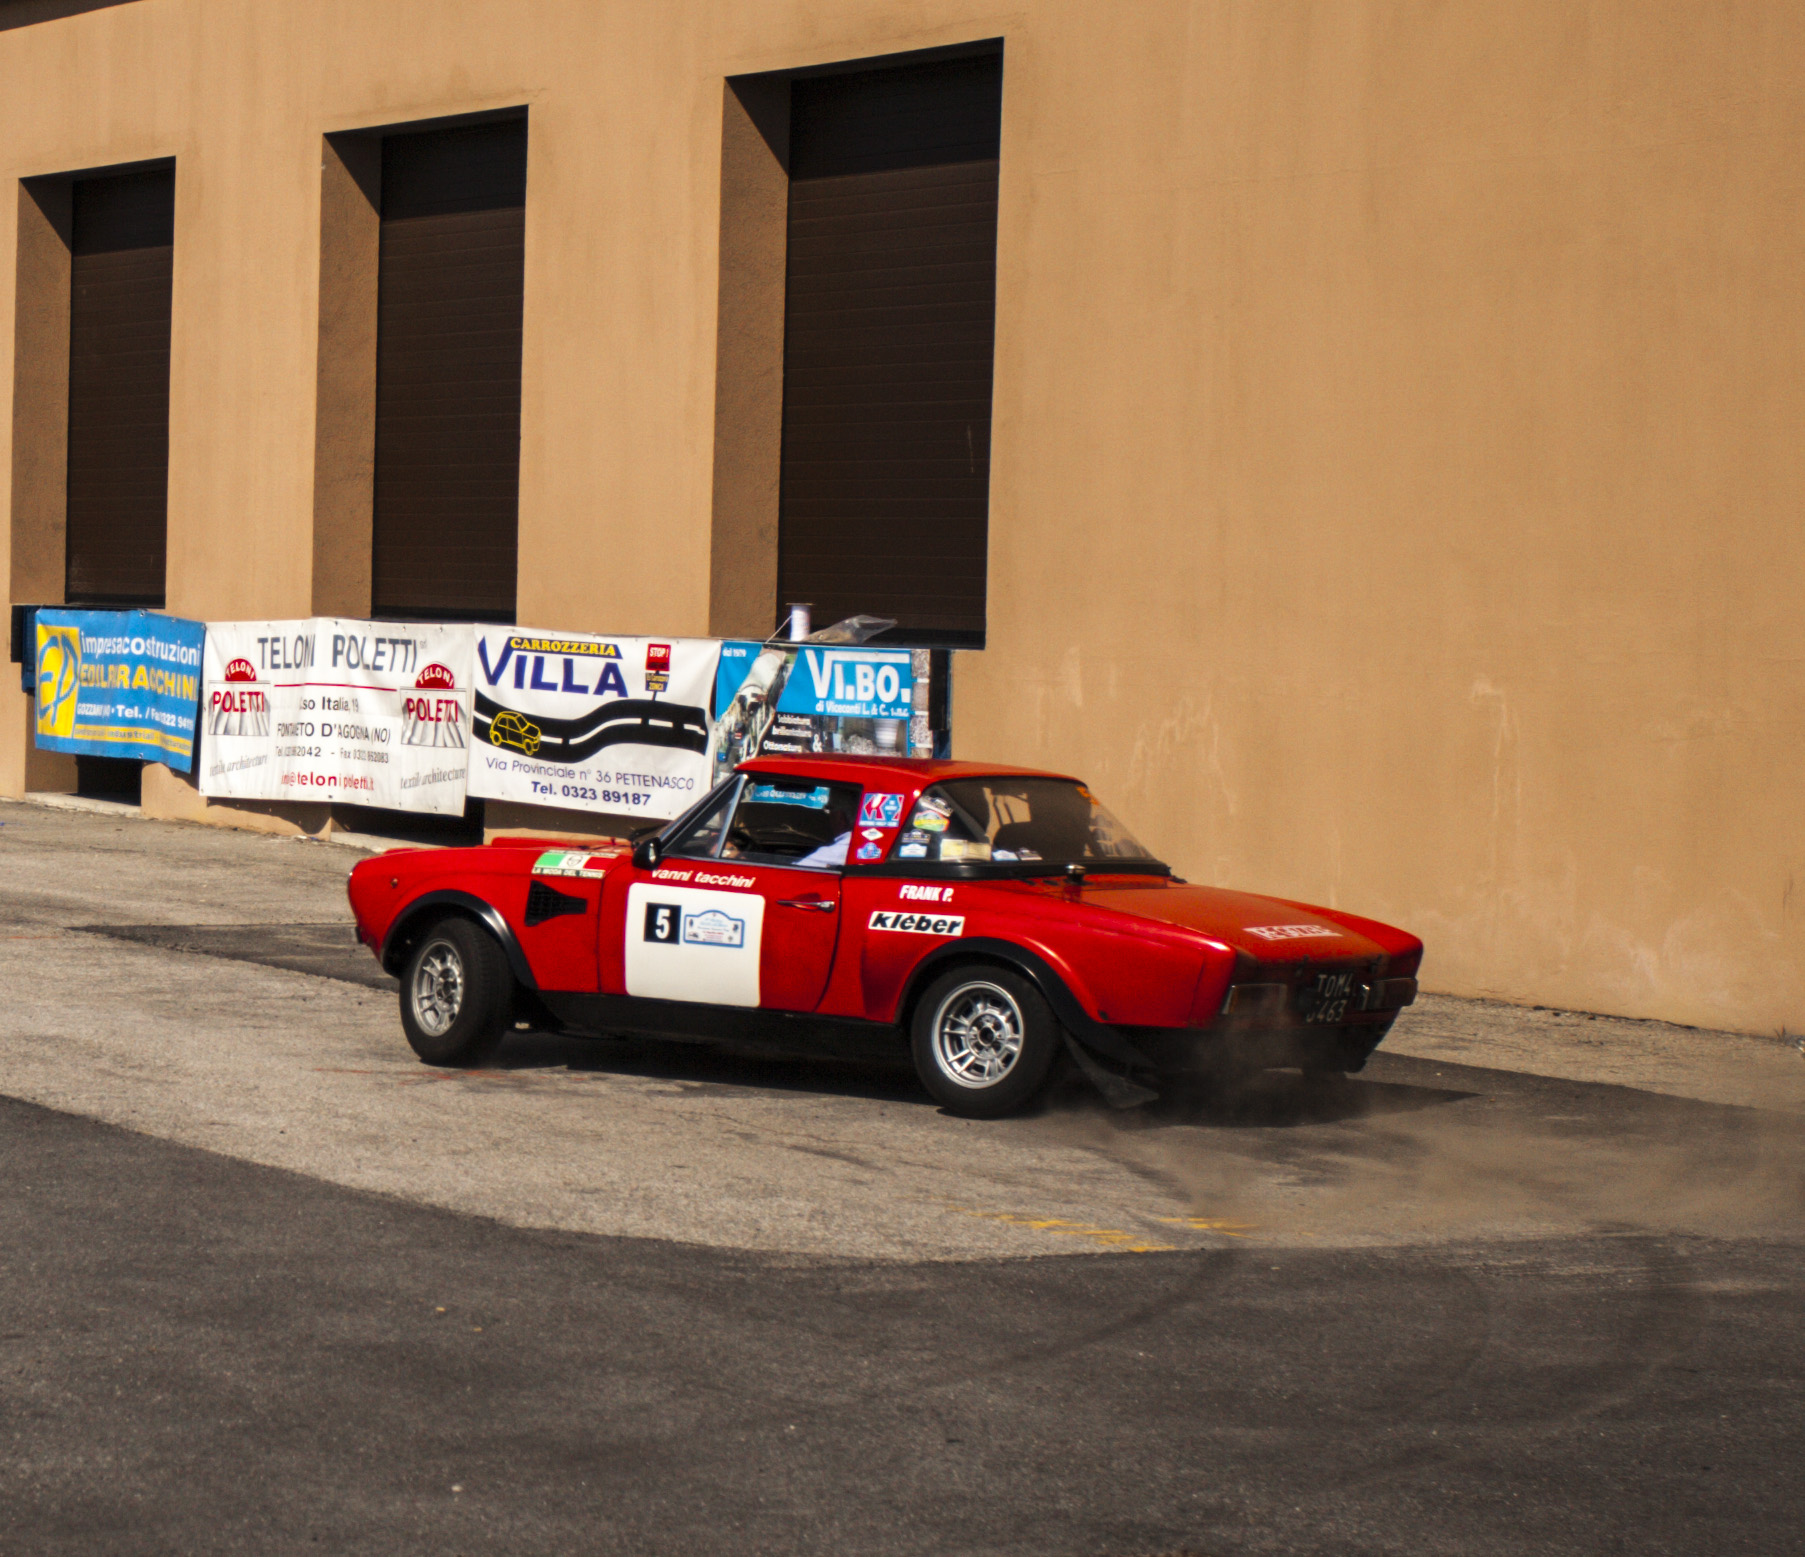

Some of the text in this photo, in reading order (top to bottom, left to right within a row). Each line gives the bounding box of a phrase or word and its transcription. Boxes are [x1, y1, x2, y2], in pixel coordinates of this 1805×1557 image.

[258, 634, 316, 670] TELONI
[332, 634, 418, 673] POLETTI
[510, 637, 617, 657] CARROZZERIA
[225, 661, 256, 679] TELONI
[418, 666, 455, 686] TELONI
[478, 635, 629, 699] VILLA
[212, 691, 266, 713] POLETTI
[816, 700, 825, 712] di
[485, 756, 507, 771] Via
[512, 760, 576, 781] Provinciale
[595, 770, 612, 785] 36
[615, 772, 694, 791] PETTENASCO
[531, 781, 651, 807] Tel. 0323 89187
[695, 871, 756, 888] tacchini
[900, 884, 954, 902] FRANK P.
[655, 908, 670, 940] 5
